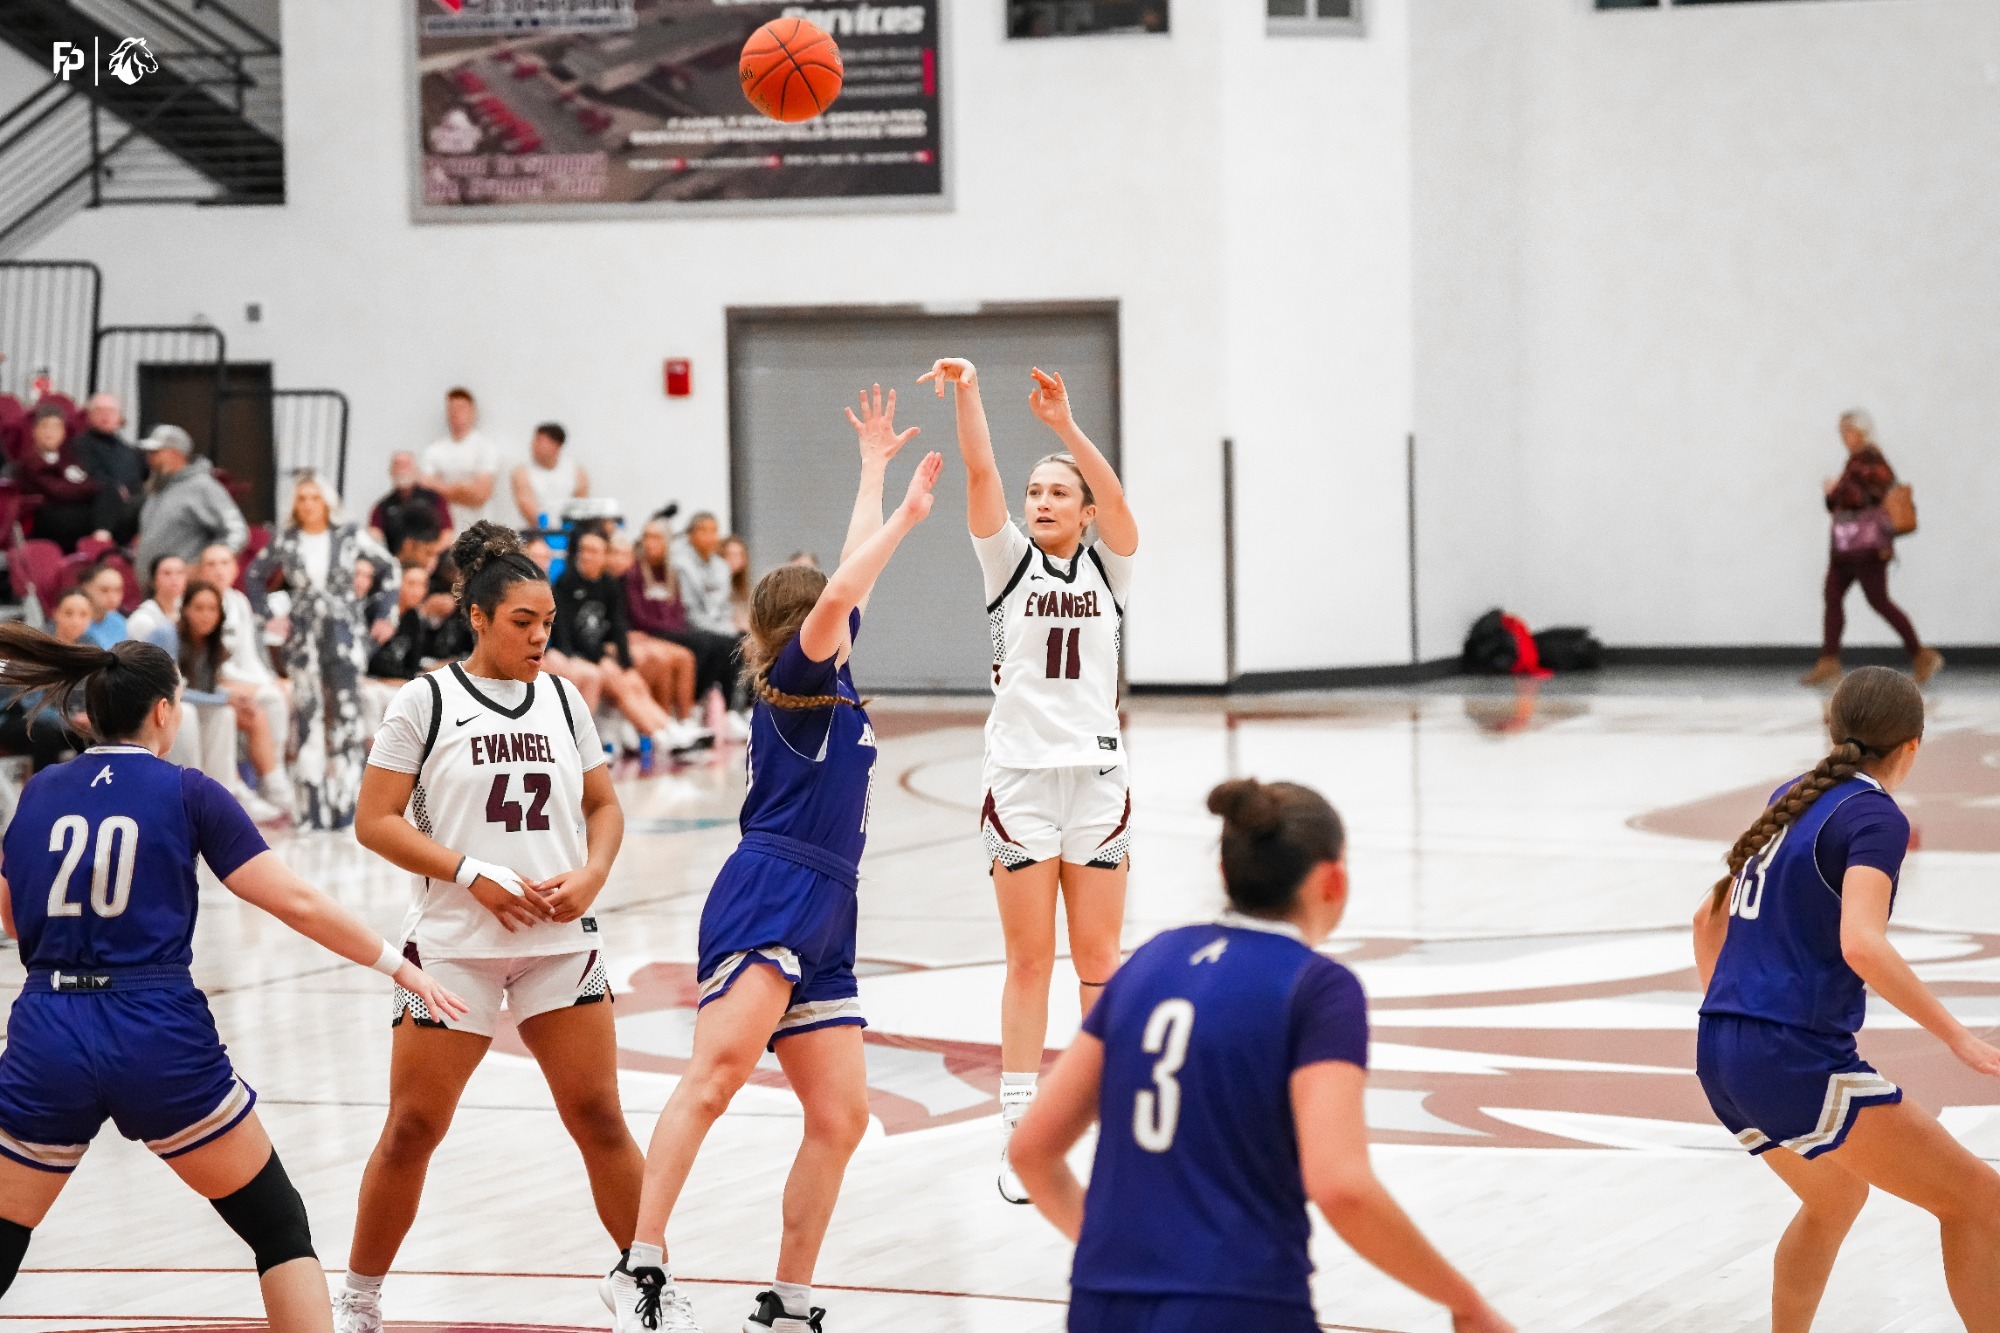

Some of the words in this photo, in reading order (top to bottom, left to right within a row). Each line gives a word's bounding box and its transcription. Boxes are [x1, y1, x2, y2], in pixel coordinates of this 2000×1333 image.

[1024, 590, 1102, 618] EVANGEL
[1045, 627, 1081, 679] 11
[471, 732, 555, 765] EVANGEL
[485, 773, 552, 832] 42
[48, 814, 139, 918] 20
[1132, 998, 1196, 1154] 3
